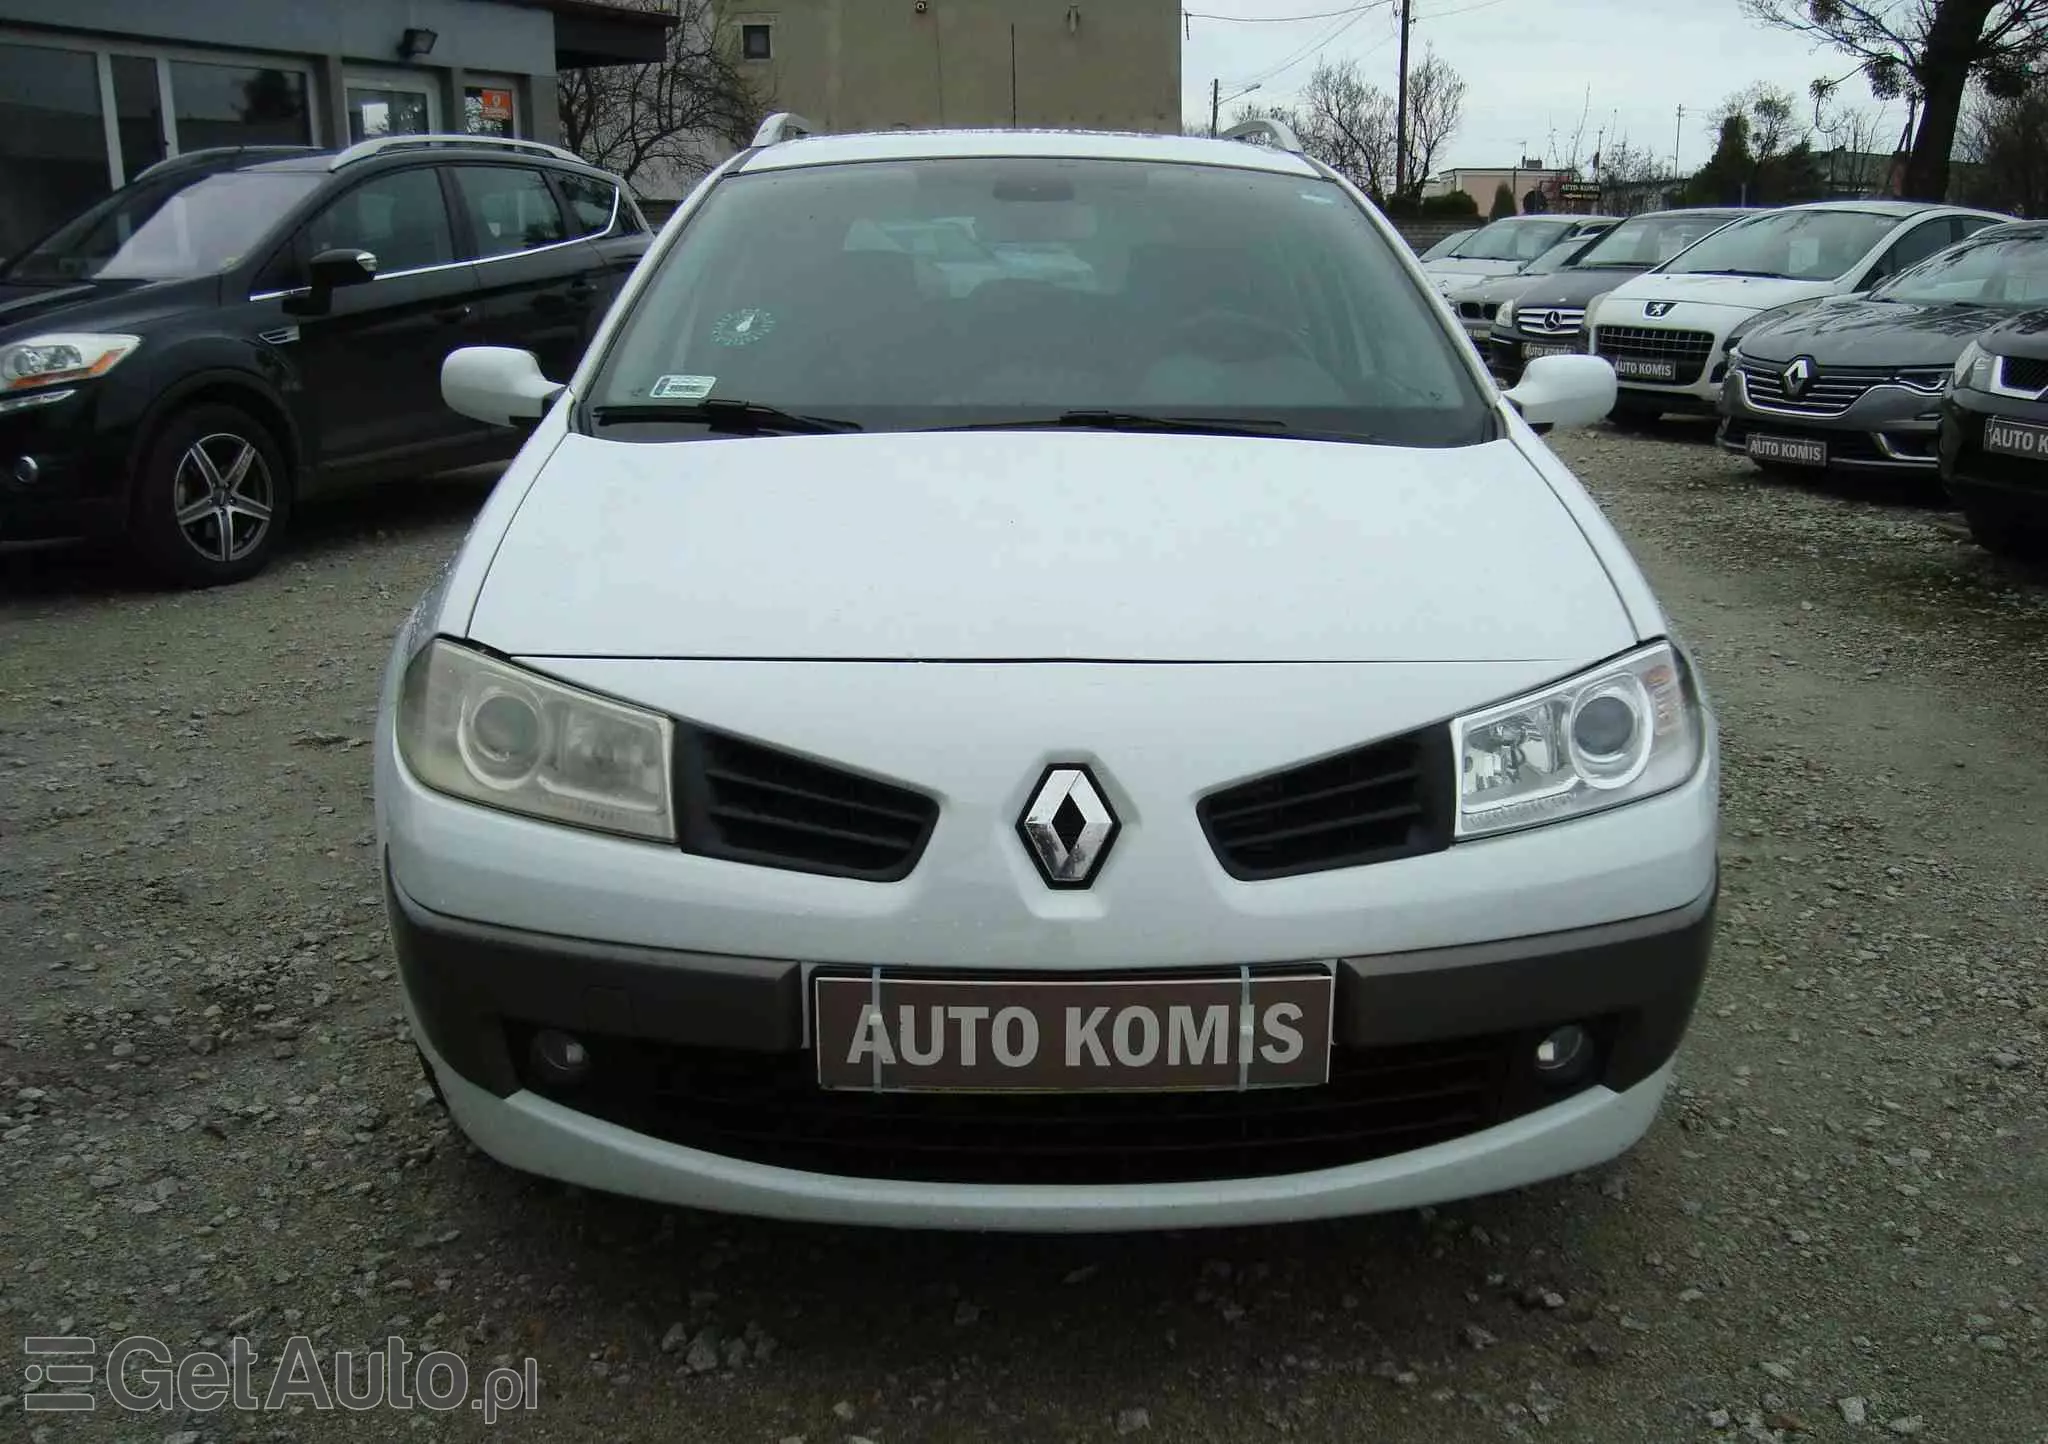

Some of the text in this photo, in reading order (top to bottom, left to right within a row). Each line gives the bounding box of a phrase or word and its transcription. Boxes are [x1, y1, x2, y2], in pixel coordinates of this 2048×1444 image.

[1639, 363, 1671, 376] KOMIS
[1991, 427, 2034, 450] AUTO
[1750, 440, 1821, 461] AUTO KOMIS
[847, 1002, 1304, 1068] AUTO KOMIS
